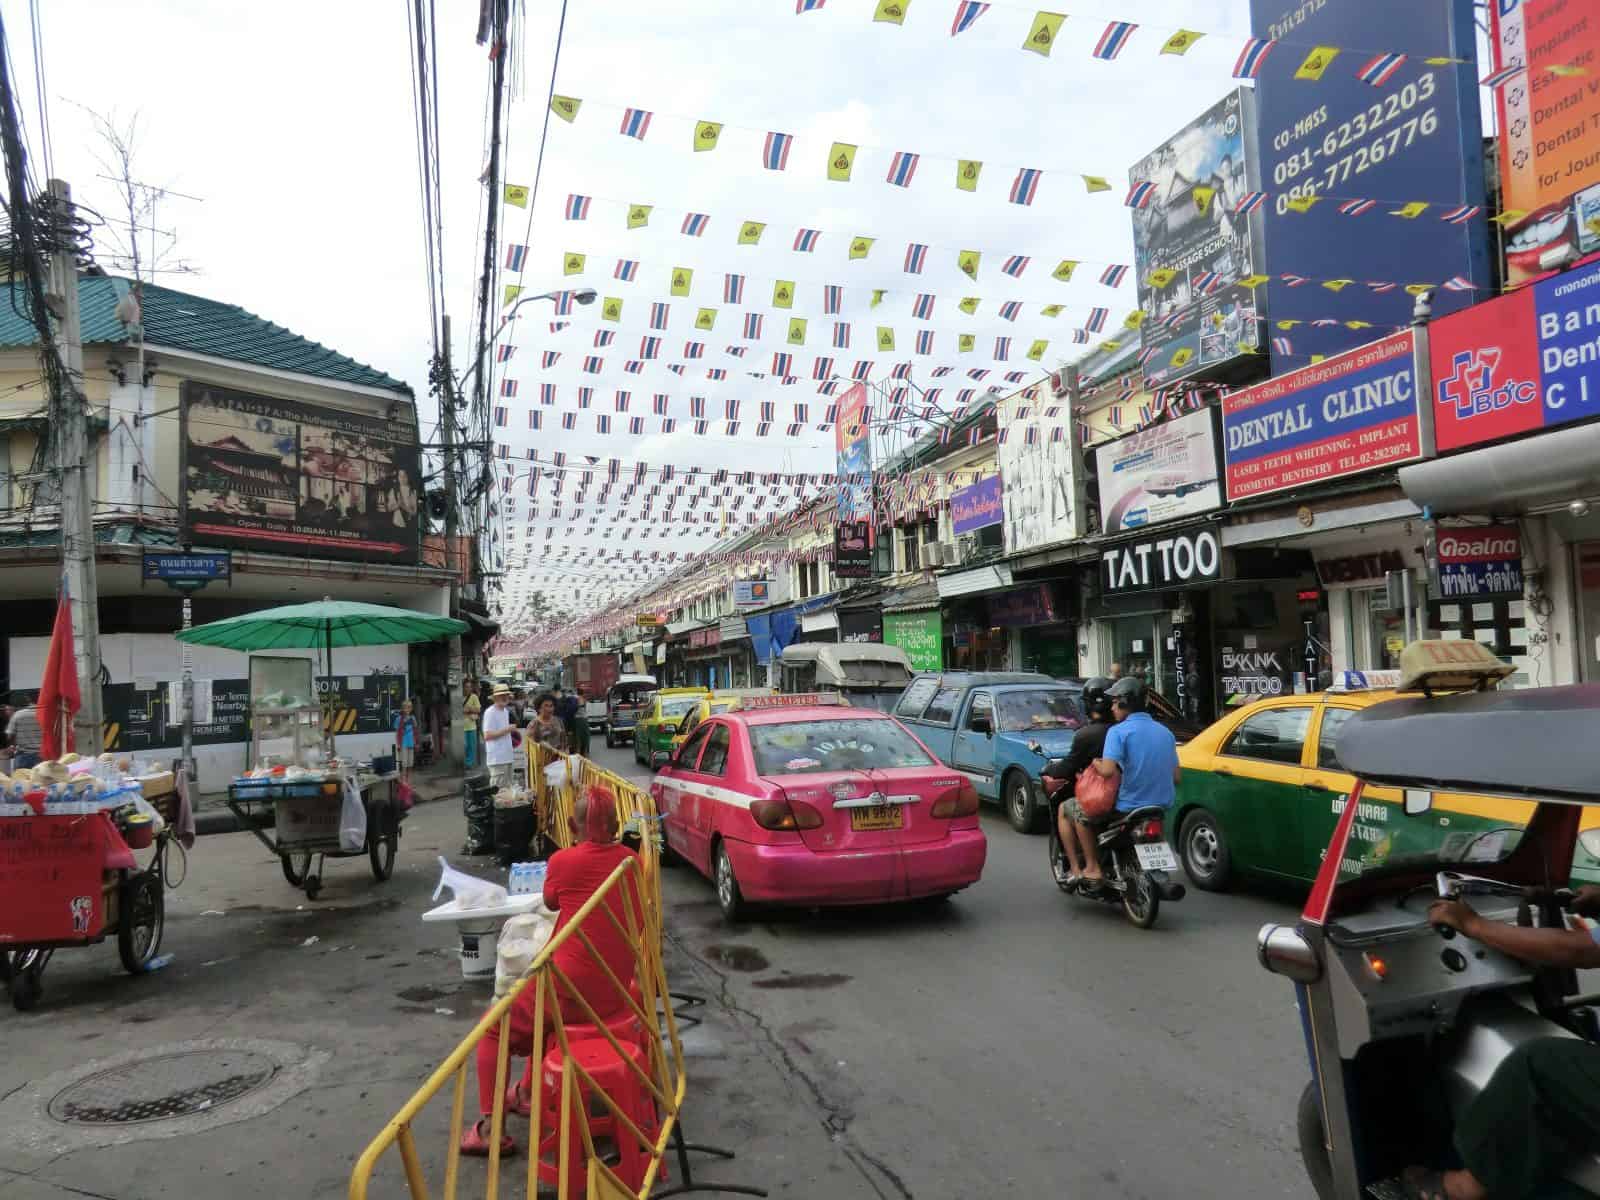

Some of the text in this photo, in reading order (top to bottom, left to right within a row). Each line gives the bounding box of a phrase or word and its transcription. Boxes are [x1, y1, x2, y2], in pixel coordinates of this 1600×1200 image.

[1529, 16, 1589, 62] Implant
[1273, 105, 1328, 151] CO-MASS
[1273, 72, 1436, 185] 081-6232203
[1533, 87, 1584, 125] Dental
[1275, 107, 1438, 215] 086-7726776
[1535, 119, 1586, 158] Dental
[1537, 168, 1560, 190] for
[1228, 403, 1312, 451] DENTAL
[1322, 370, 1412, 423] CLINIC
[1233, 461, 1259, 478] LASER
[1264, 453, 1292, 471] TEETH
[1359, 422, 1409, 445] IMPLANT
[1234, 474, 1276, 495] COSMETIC
[1281, 461, 1333, 483] DENTISTRY
[1103, 531, 1217, 589] TATTOO
[1222, 675, 1282, 694] TATTOO
[1254, 651, 1282, 672] INK
